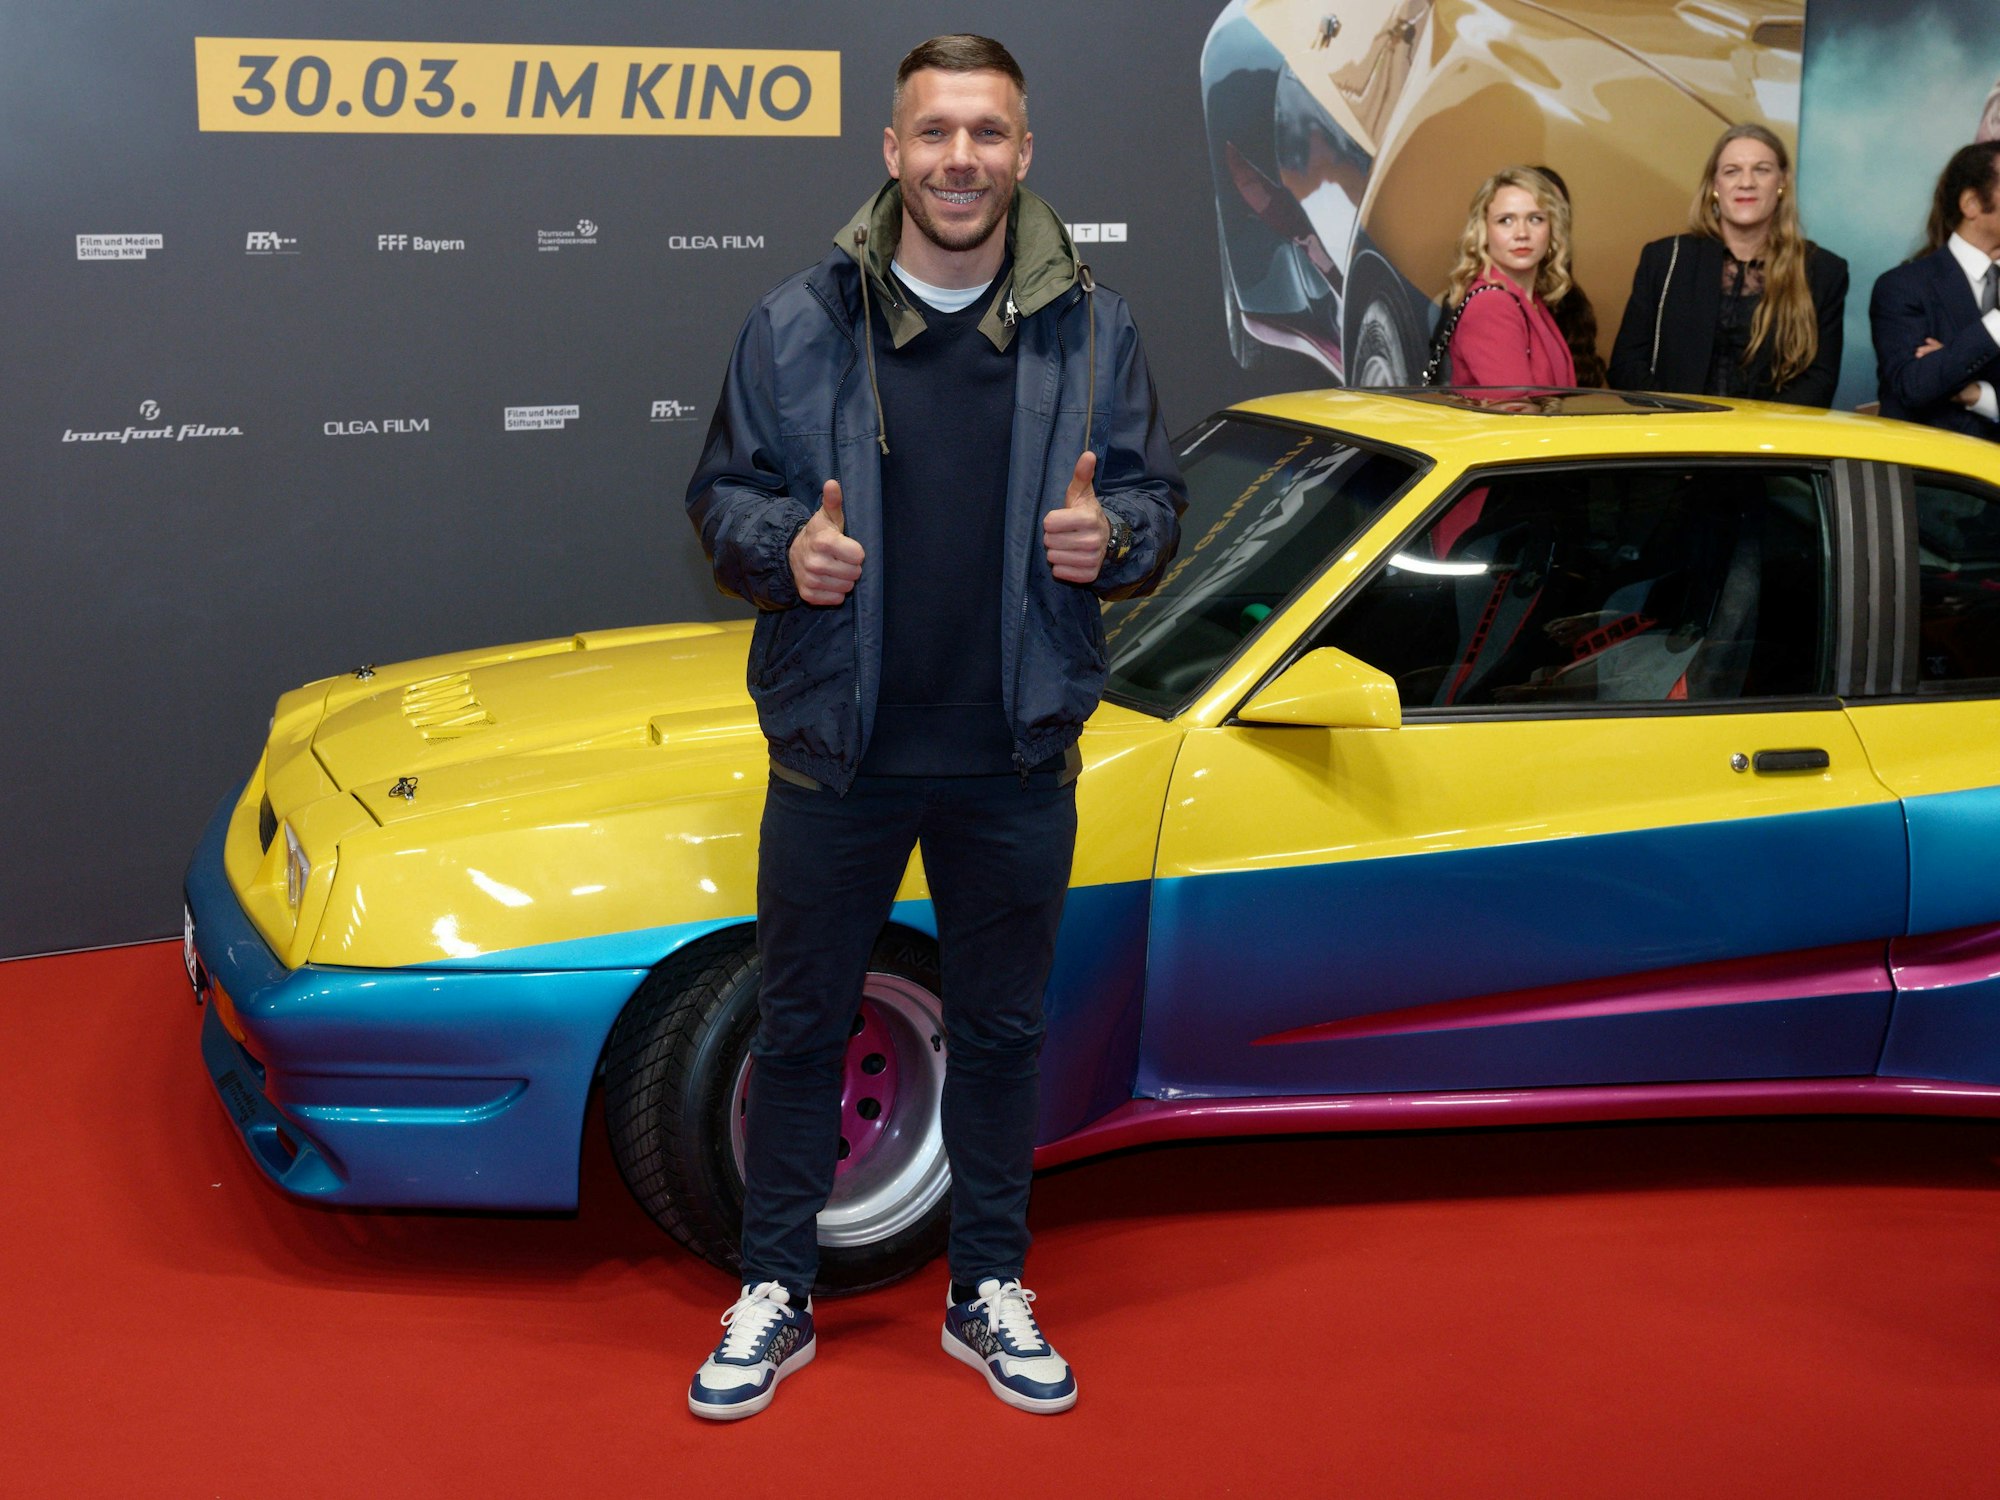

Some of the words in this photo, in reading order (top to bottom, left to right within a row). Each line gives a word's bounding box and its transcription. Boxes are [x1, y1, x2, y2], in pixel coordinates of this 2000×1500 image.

[232, 55, 476, 119] 30.03.
[505, 60, 599, 119] IM
[621, 62, 812, 121] KINO
[80, 237, 102, 246] Film
[104, 237, 122, 246] und
[125, 237, 160, 246] Medien
[378, 234, 407, 251] FFF
[413, 237, 465, 253] Bayern
[669, 236, 718, 249] OLGA
[722, 235, 764, 248] FILM
[80, 248, 120, 257] Stiftung
[122, 248, 144, 256] NRW
[507, 409, 527, 418] Film
[528, 409, 545, 417] und
[546, 408, 577, 417] Medien
[324, 420, 379, 435] OLGA
[383, 418, 429, 433] FILM
[507, 419, 542, 428] Stiftung
[543, 418, 562, 426] NRW
[62, 426, 174, 443] barefoot
[176, 424, 244, 441] films
